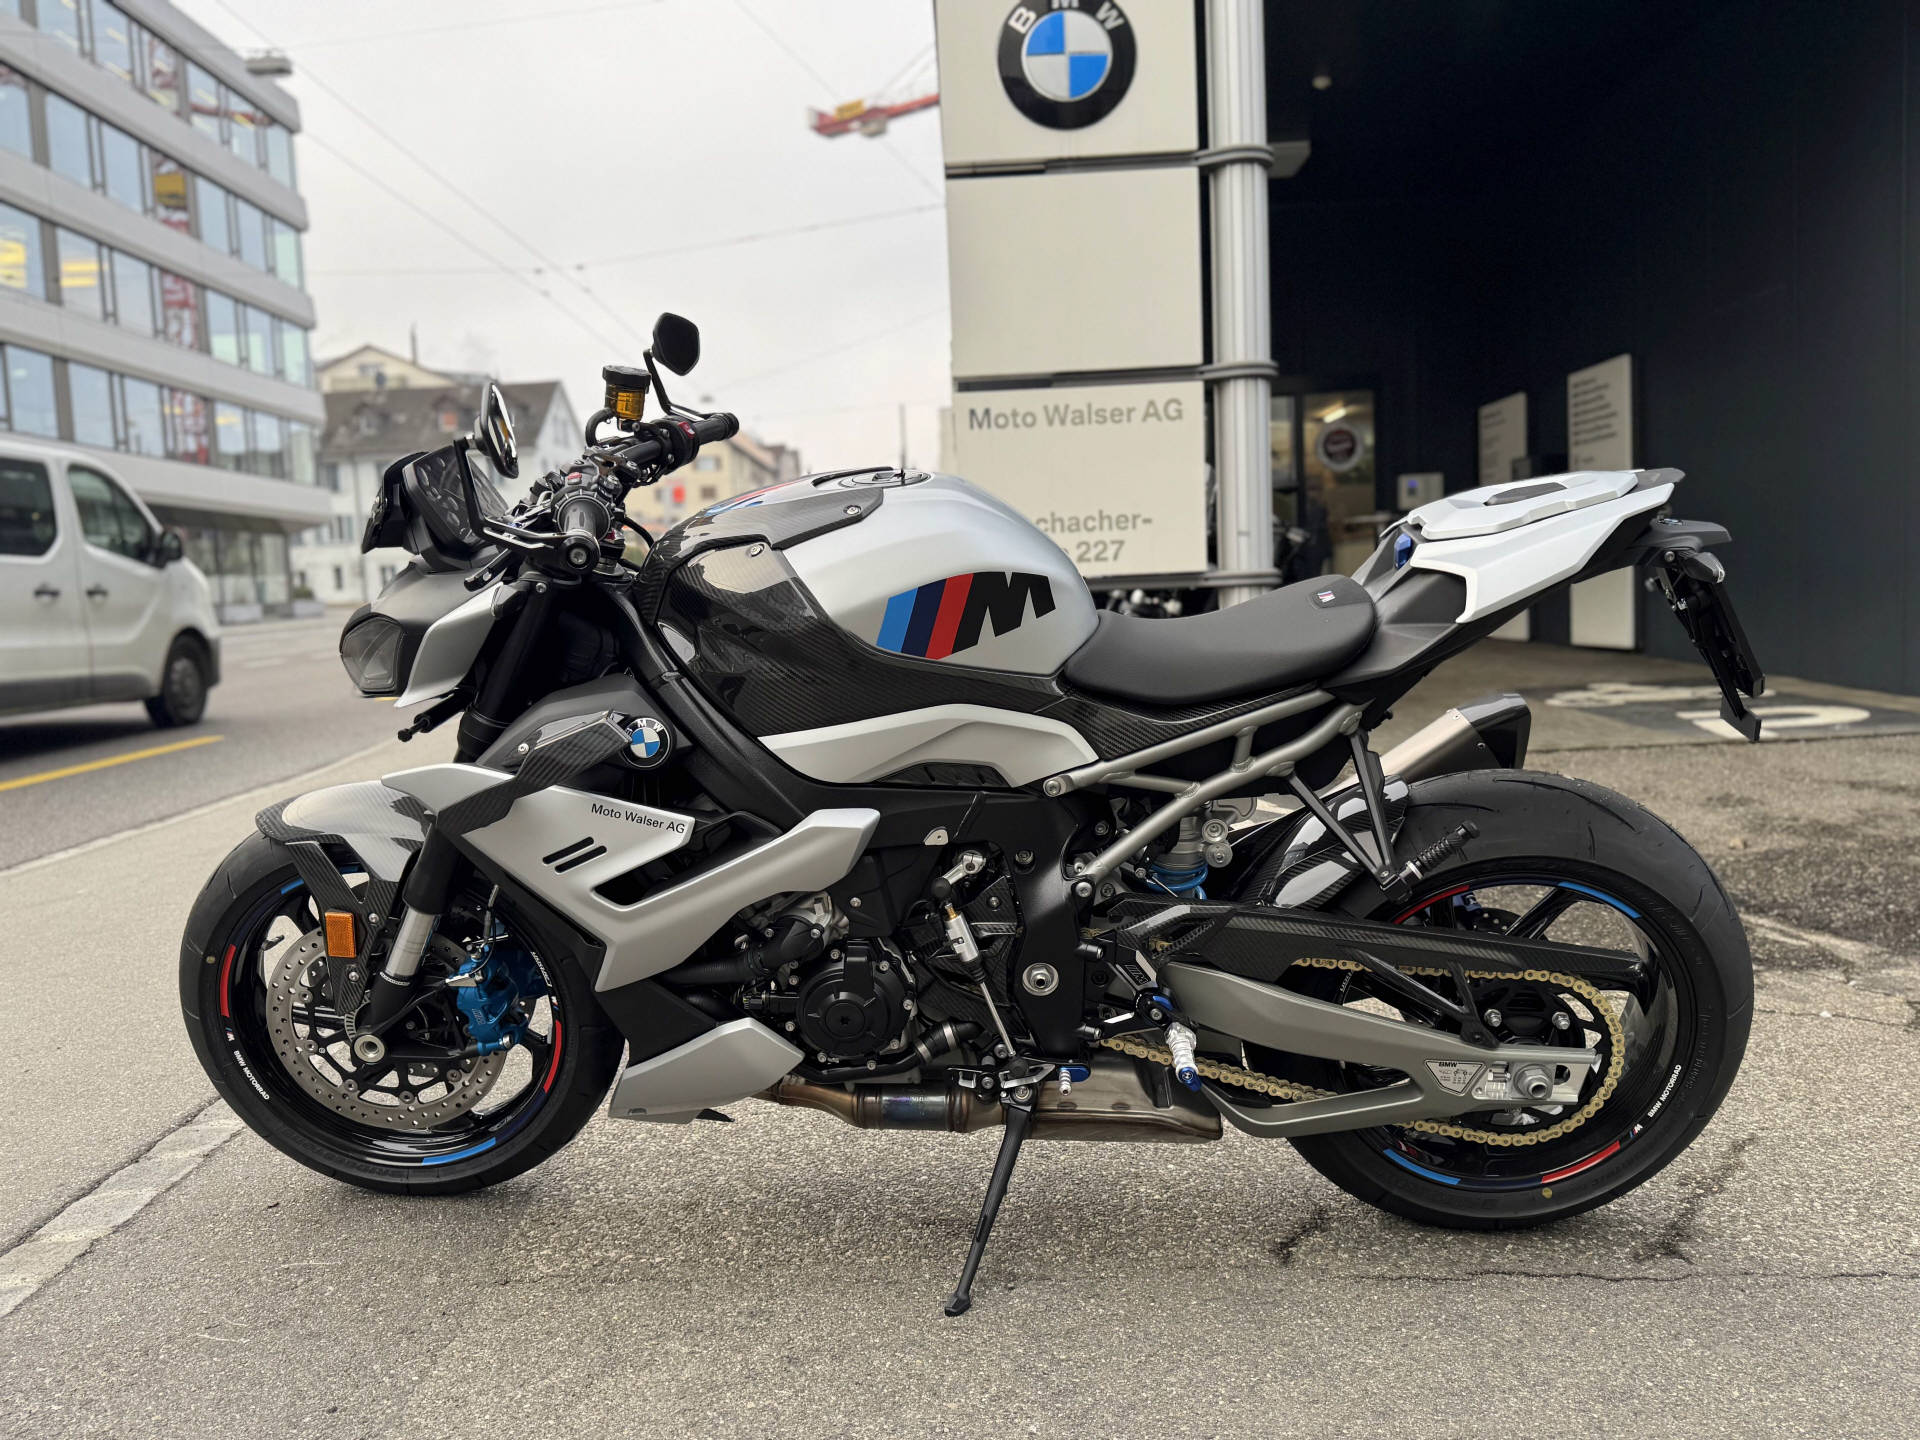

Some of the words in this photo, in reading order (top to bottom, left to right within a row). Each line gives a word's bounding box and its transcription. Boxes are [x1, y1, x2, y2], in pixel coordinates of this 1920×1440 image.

[968, 407, 1037, 431] Moto
[1042, 402, 1136, 428] Walser
[1141, 397, 1184, 422] AG
[1076, 540, 1125, 563] 227
[591, 803, 622, 819] Moto
[625, 810, 665, 829] Walser
[665, 820, 686, 834] AG
[233, 1050, 247, 1067] BMW
[242, 1066, 270, 1100] MOTORRAD
[1647, 1100, 1662, 1118] BMW
[1659, 1064, 1682, 1102] MOTORRAD
